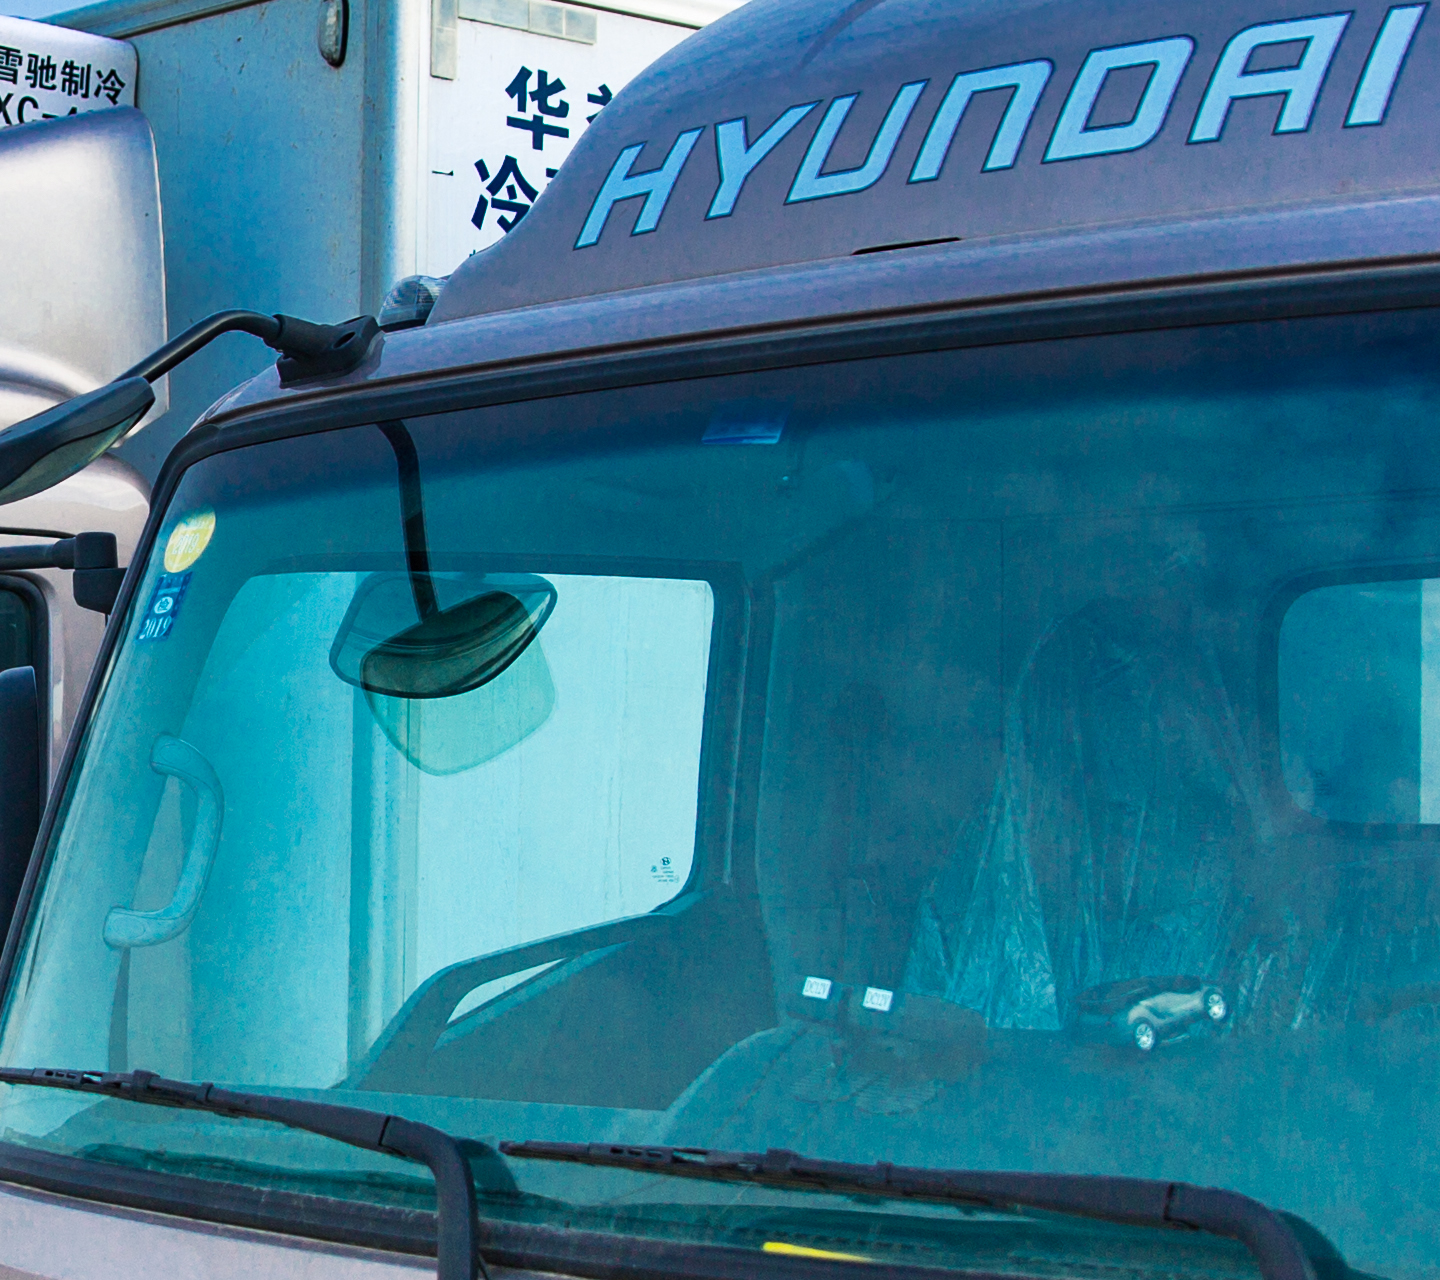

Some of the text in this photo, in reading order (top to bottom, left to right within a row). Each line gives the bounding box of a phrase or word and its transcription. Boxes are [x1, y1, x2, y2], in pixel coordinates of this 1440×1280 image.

[505, 66, 613, 151] 华
[572, 1, 1430, 251] HYUNDAI
[139, 615, 173, 640] 2019
